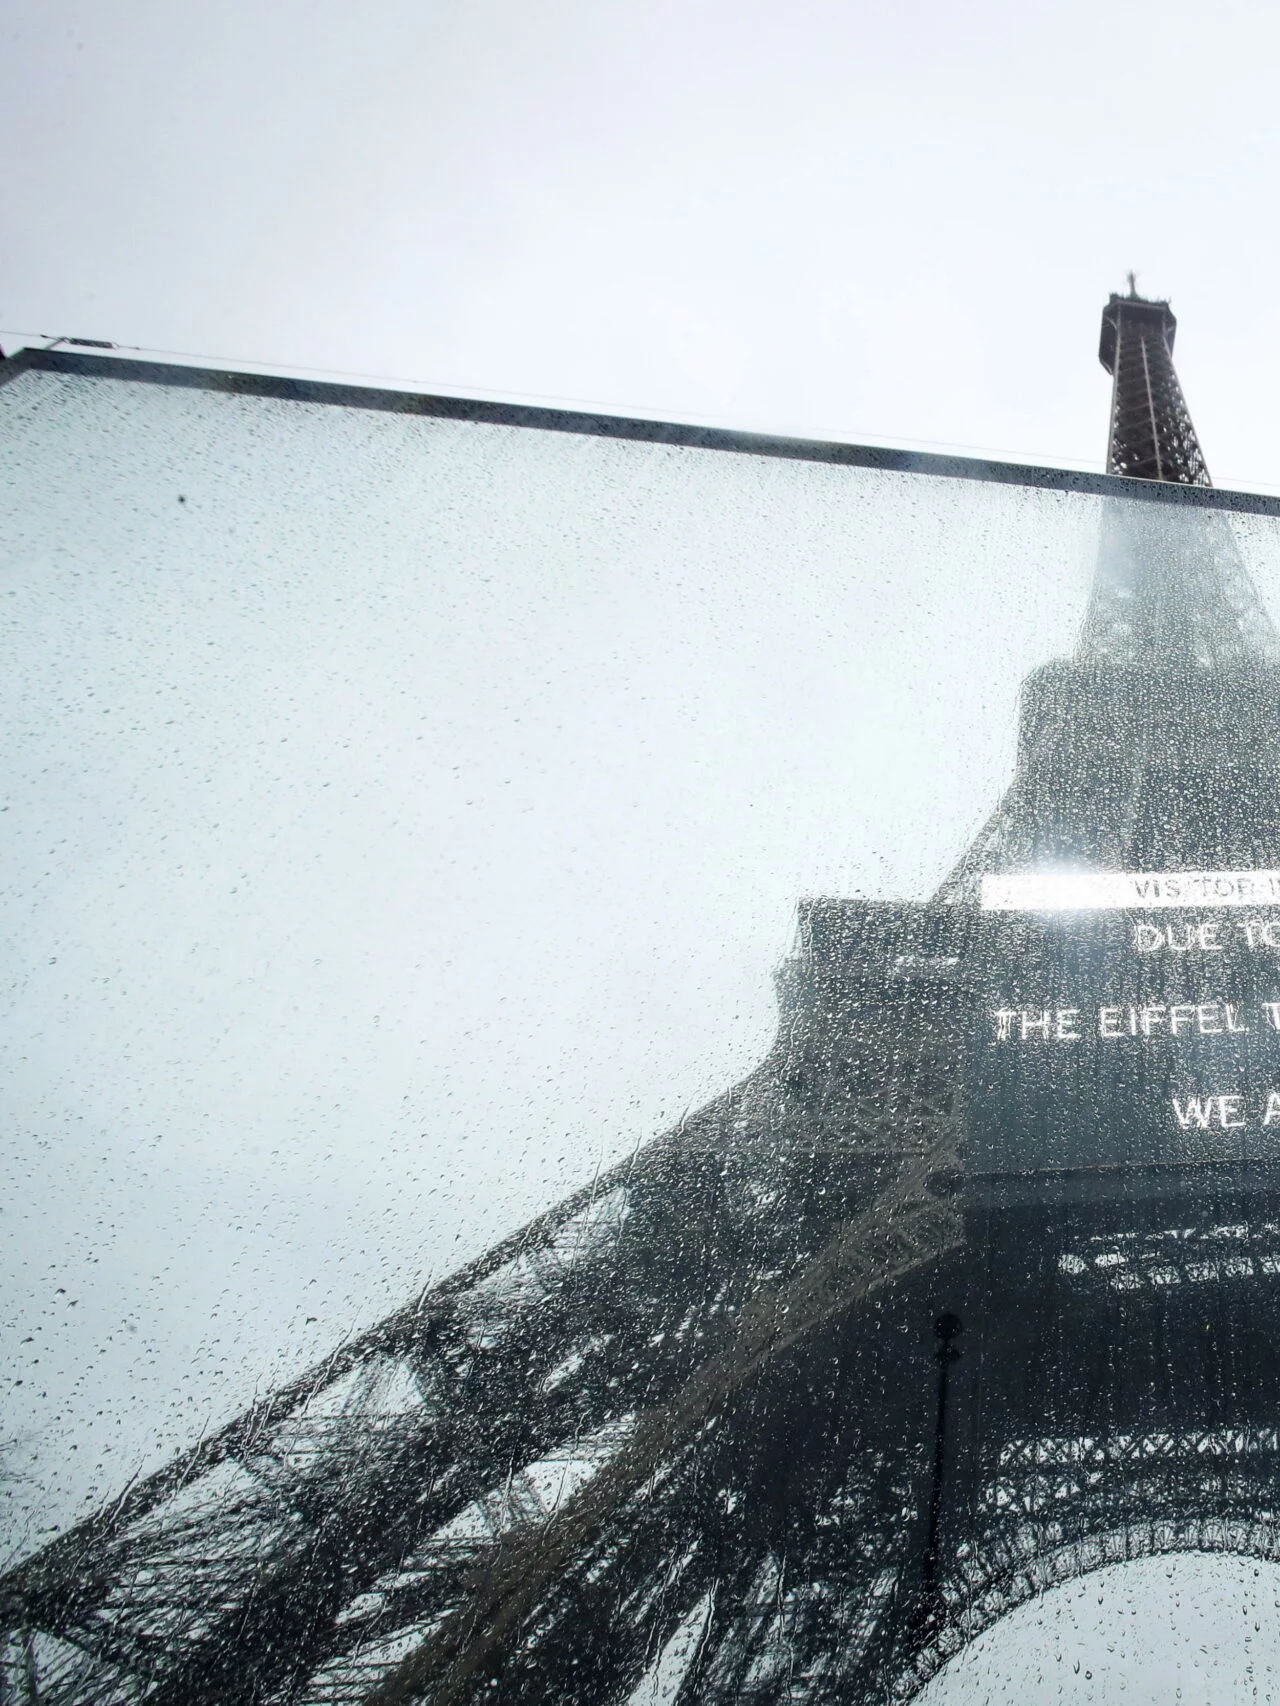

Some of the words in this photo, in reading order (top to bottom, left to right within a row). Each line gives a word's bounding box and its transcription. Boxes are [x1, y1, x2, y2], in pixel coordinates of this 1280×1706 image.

[1133, 878, 1254, 898] VISITOR
[1135, 923, 1223, 951] DUE
[994, 1007, 1082, 1040] THE
[1099, 1002, 1248, 1037] EIFFEL
[1171, 1095, 1246, 1128] WE
